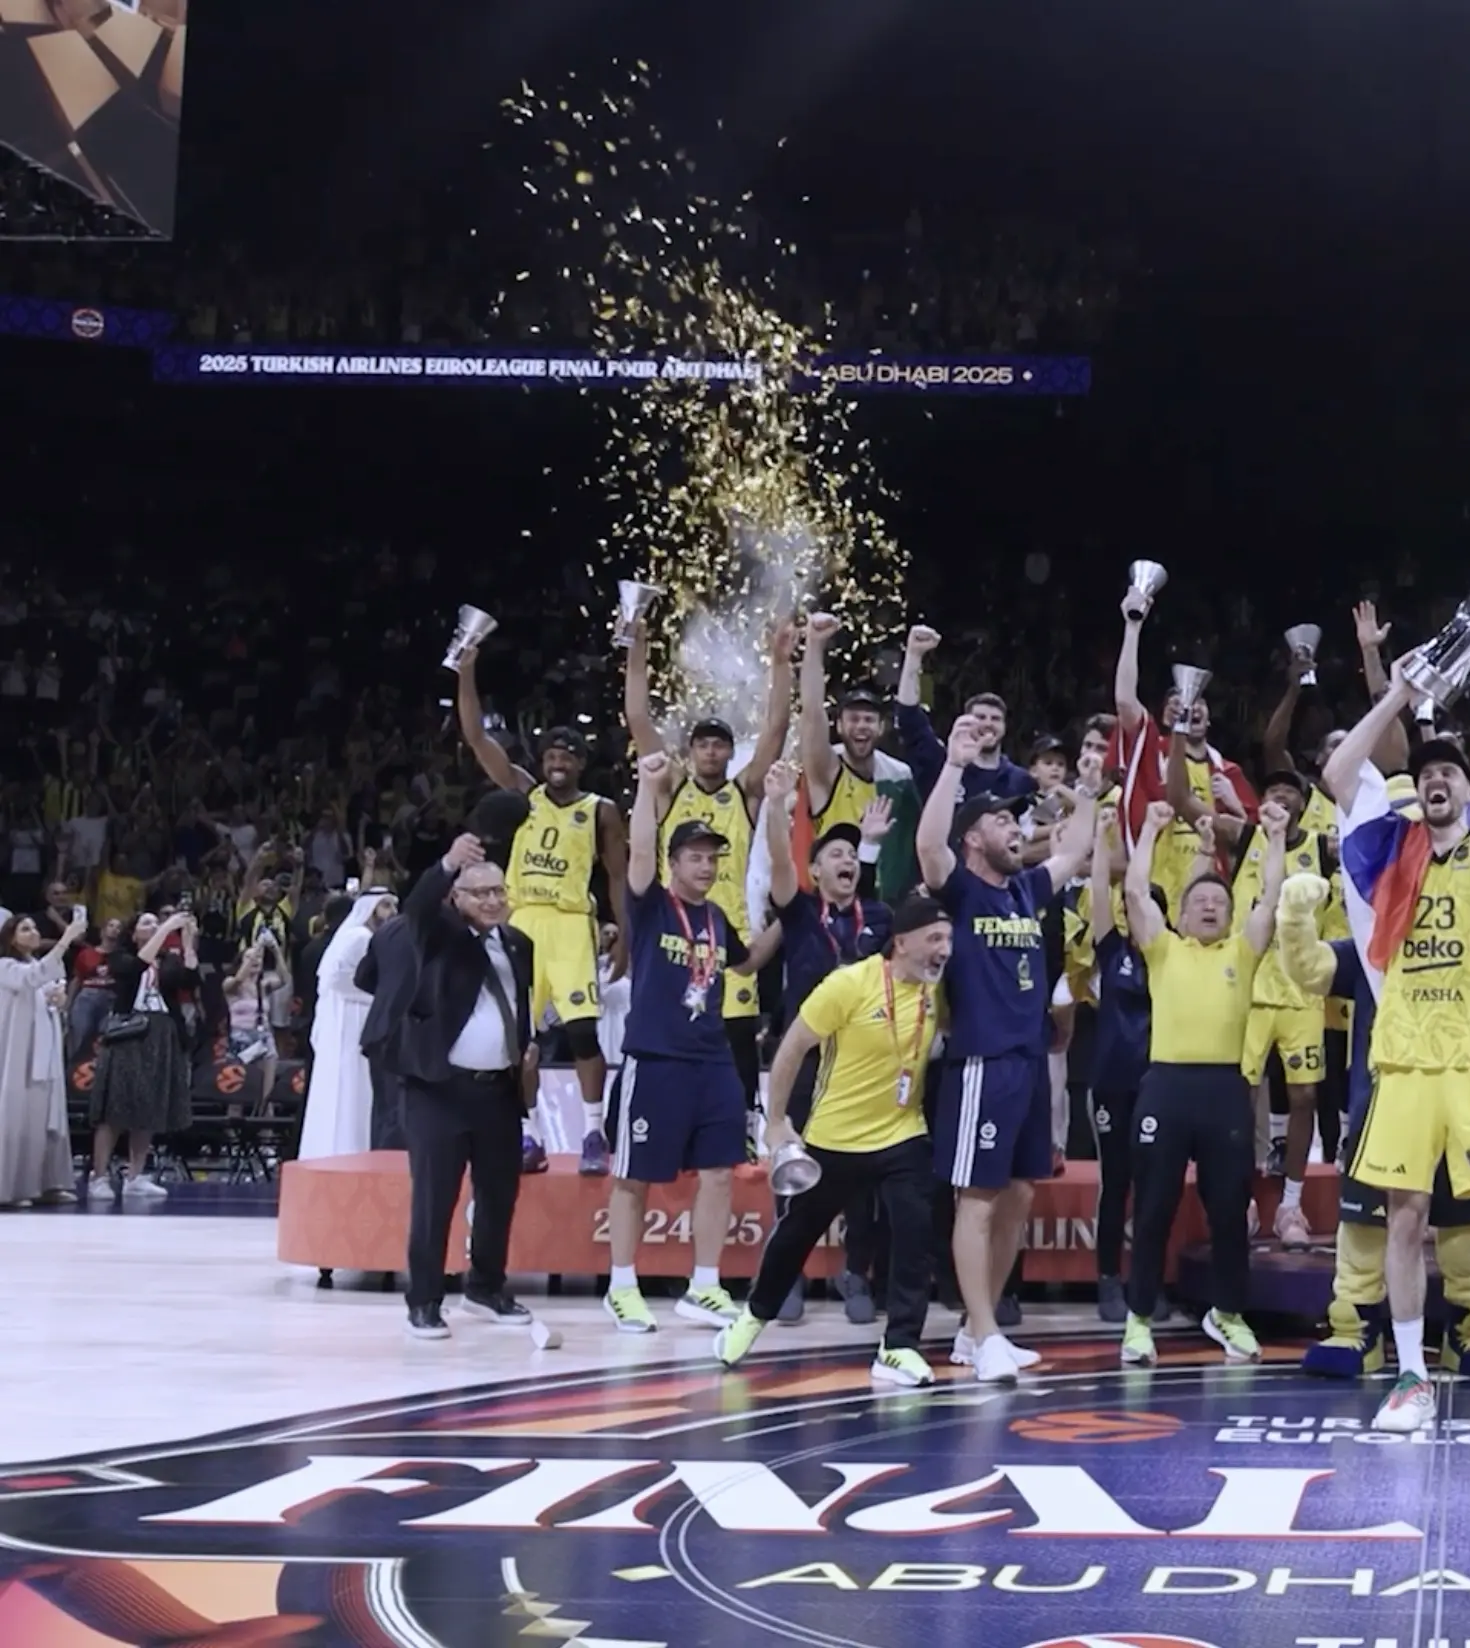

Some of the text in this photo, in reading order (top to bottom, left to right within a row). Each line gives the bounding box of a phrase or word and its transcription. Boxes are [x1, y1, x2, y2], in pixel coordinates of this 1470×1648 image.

[199, 354, 248, 372] 2025
[250, 355, 335, 373] TURKISH
[336, 356, 422, 374] AIRLINES
[425, 357, 546, 376] EUROLEAGUE
[548, 358, 604, 377] FINAL
[606, 359, 658, 378] FOUR
[660, 360, 701, 379] ABU
[826, 363, 1013, 384] ABU DHABI 2025
[540, 826, 559, 850] 0
[523, 848, 569, 872] beko
[1414, 895, 1456, 930] 23
[1403, 935, 1465, 958] beko
[1412, 988, 1465, 1002] PASHA
[138, 1456, 1424, 1536] FINAL
[736, 1562, 1106, 1593] ABU
